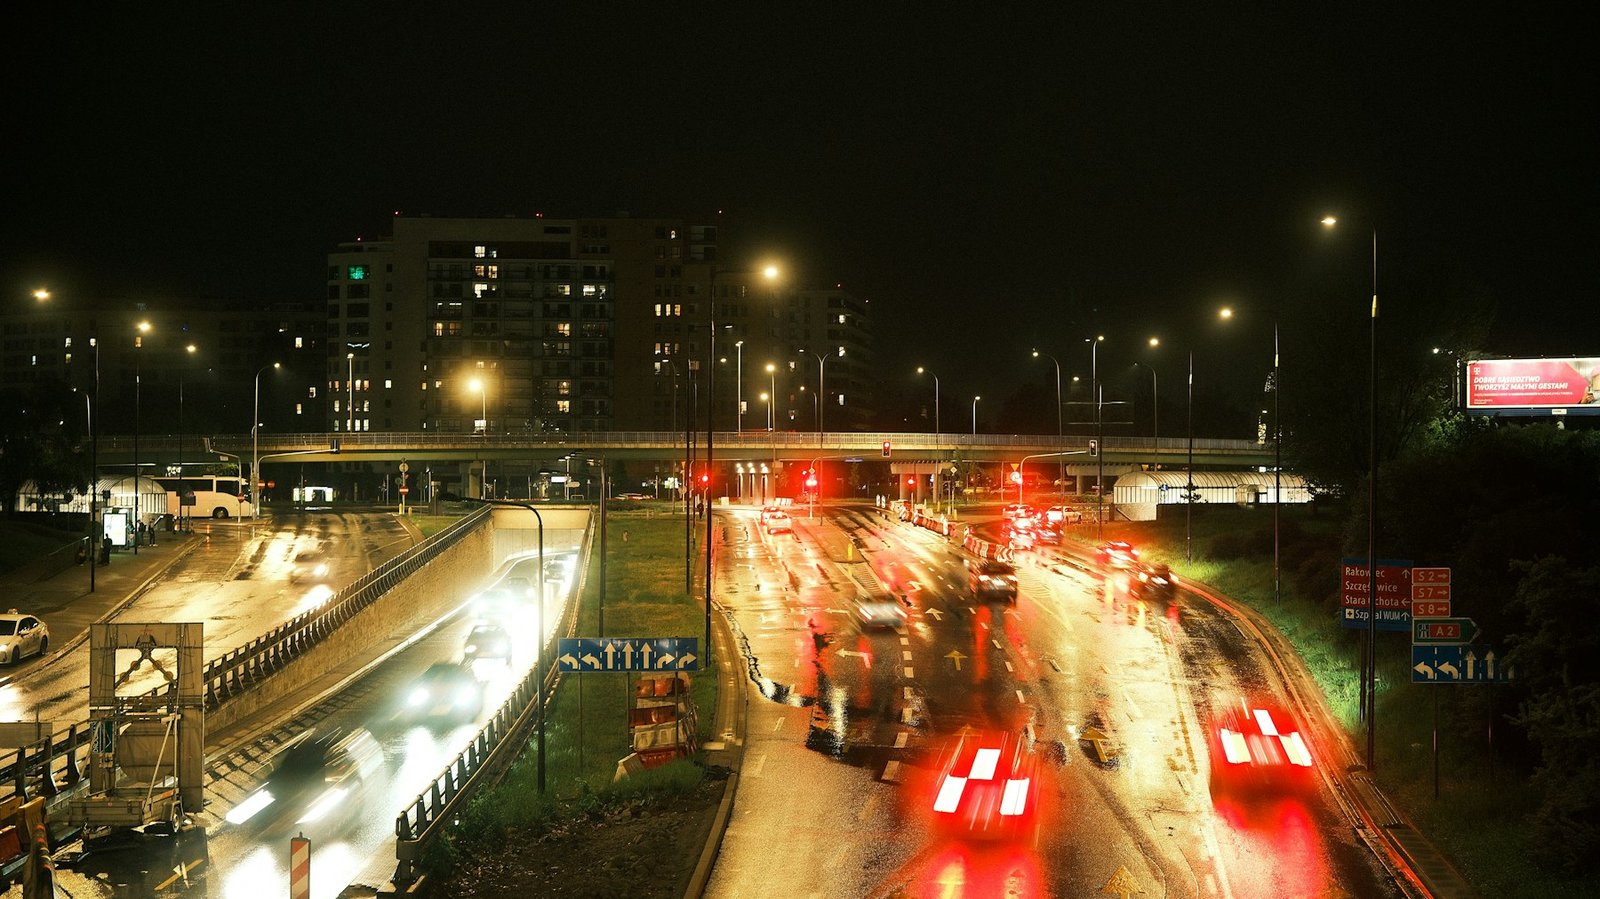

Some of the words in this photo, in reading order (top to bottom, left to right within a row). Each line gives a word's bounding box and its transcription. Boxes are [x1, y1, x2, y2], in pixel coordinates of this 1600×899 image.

[1538, 382, 1568, 390] GESTAMI
[1345, 566, 1385, 578] Rakowec
[1418, 571, 1425, 582] S
[1428, 571, 1435, 582] 2
[1345, 580, 1398, 593] Szczęświce
[1418, 587, 1425, 598] S
[1427, 587, 1434, 598] 7
[1345, 594, 1366, 605] Stara
[1355, 609, 1382, 621] Szpal
[1383, 611, 1400, 621] WUM
[1418, 604, 1425, 615] S
[1436, 627, 1444, 637] A
[1447, 627, 1454, 637] 2
